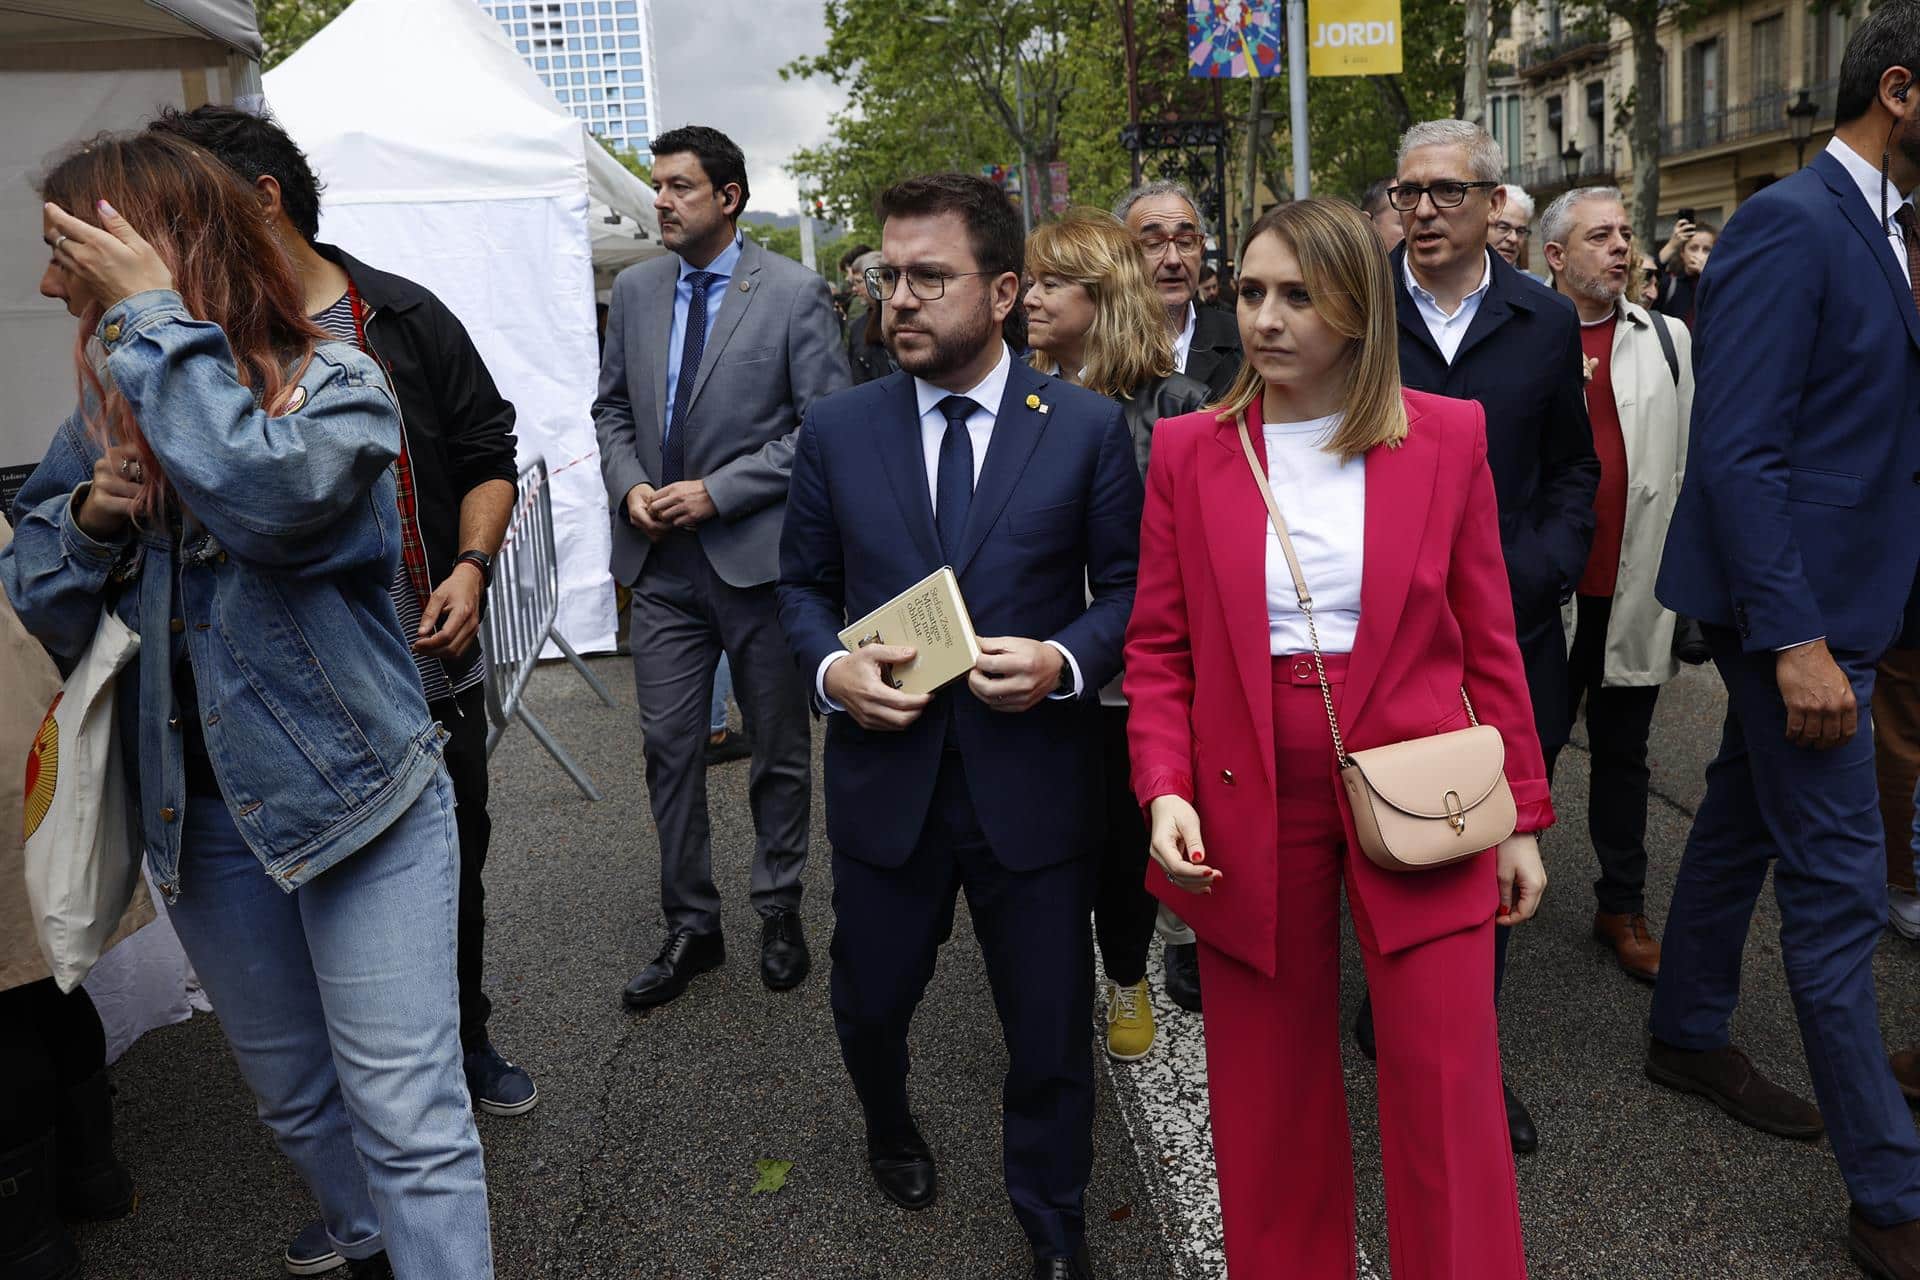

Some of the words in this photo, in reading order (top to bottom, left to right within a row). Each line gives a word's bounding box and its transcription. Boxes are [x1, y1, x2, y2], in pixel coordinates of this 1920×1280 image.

[1312, 20, 1395, 48] JORDI
[907, 602, 922, 637] oblidat
[930, 587, 943, 618] Stefan
[940, 616, 952, 649] Zweig
